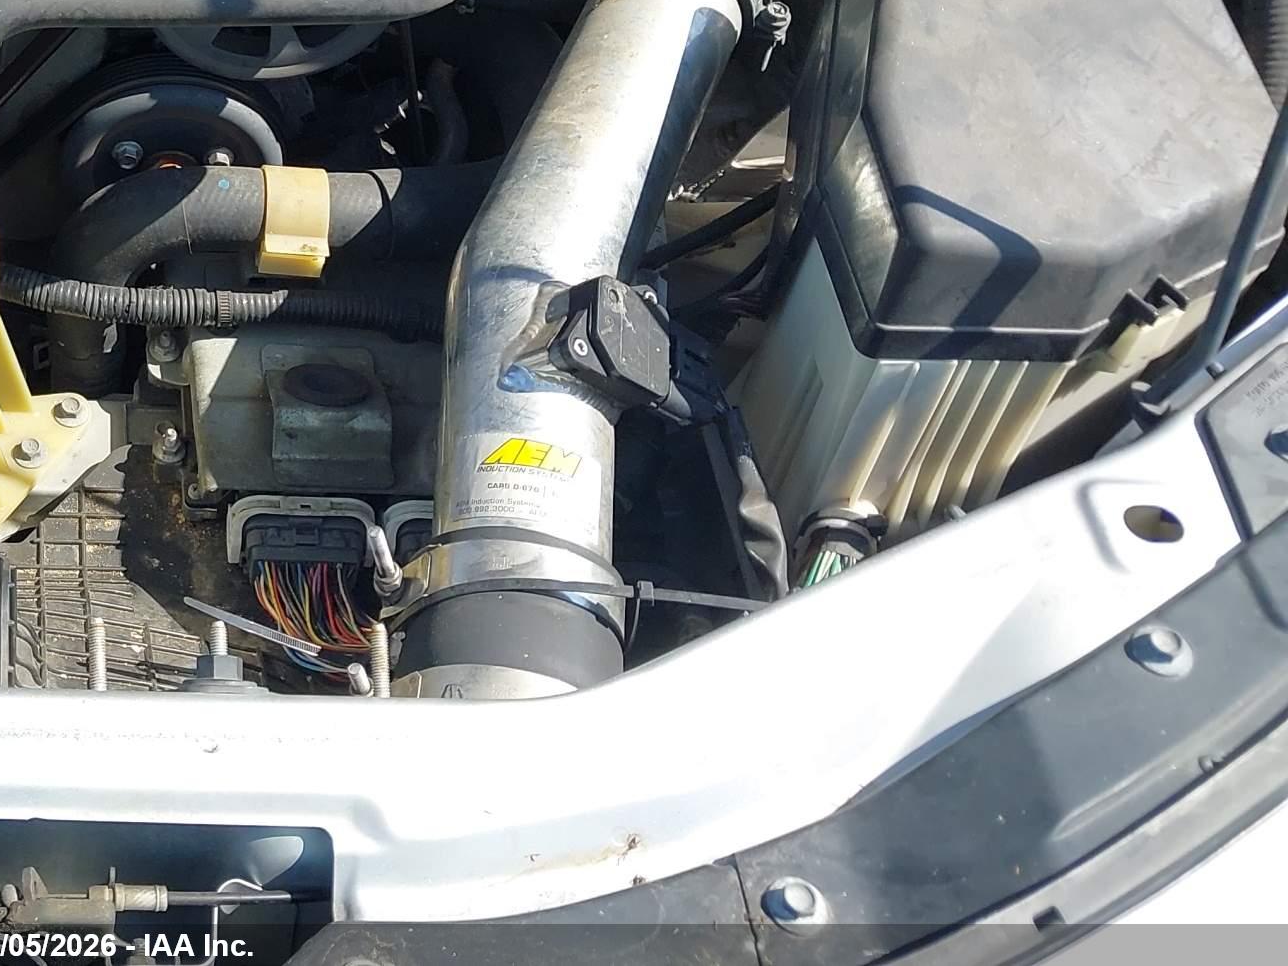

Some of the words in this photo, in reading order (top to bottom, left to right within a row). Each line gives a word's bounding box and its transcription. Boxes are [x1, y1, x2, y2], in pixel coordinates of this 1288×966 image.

[479, 437, 583, 478] AEM
[477, 465, 526, 474] INDUCTION
[472, 497, 505, 505] Induction
